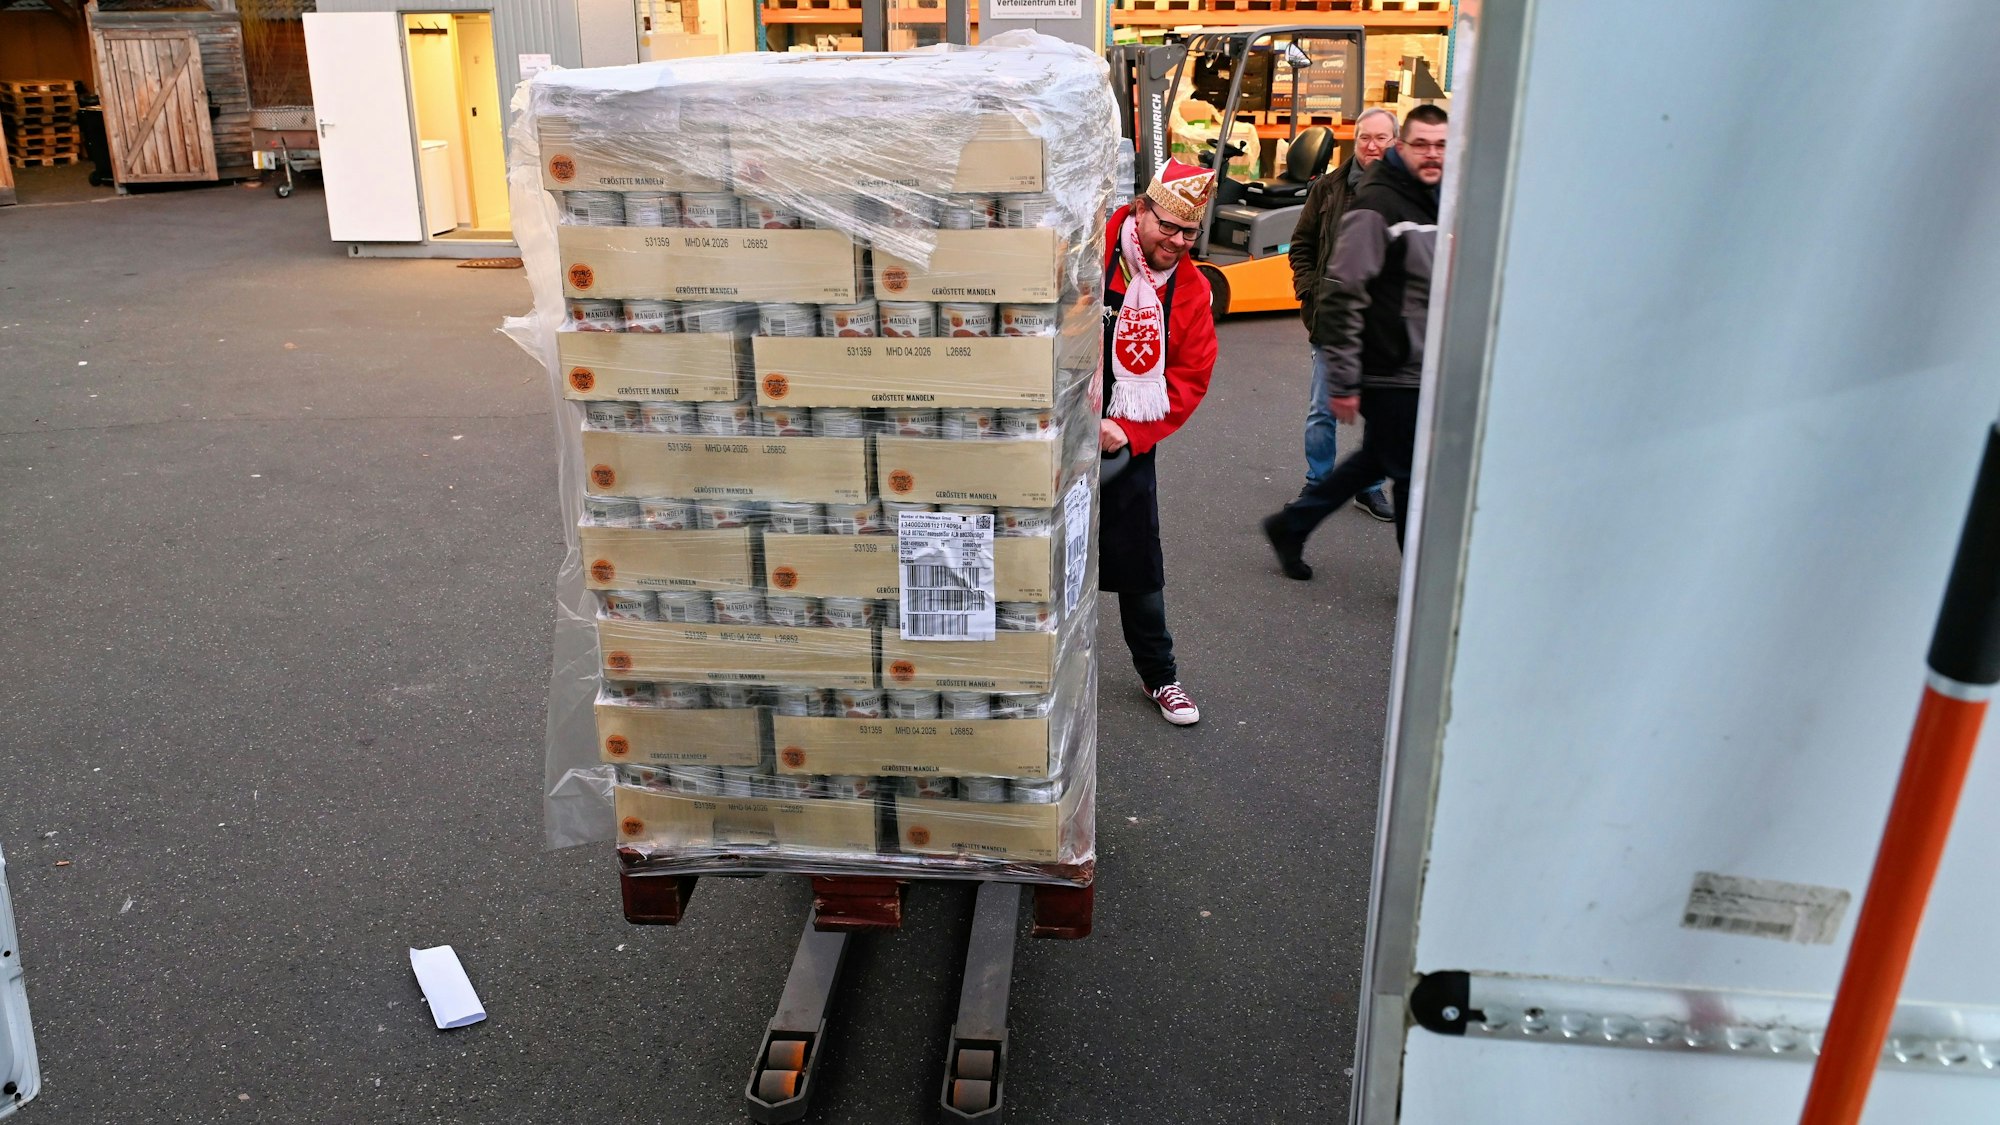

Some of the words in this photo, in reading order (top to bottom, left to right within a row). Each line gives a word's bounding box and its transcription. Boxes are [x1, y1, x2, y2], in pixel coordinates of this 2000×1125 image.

[645, 237, 670, 247] 531359
[684, 238, 700, 247] MHD
[702, 238, 729, 248] 04.2026
[742, 239, 768, 249] L26852
[675, 286, 708, 295] GERÖSTETE
[709, 287, 738, 295] MANDELN
[931, 287, 965, 296] GERÖSTETE
[966, 288, 996, 296] MANDELN
[585, 310, 614, 319] MANDELN
[634, 311, 663, 320] MANDELN
[849, 314, 875, 325] MANDELN
[889, 316, 917, 325] MANDELN
[965, 317, 992, 326] MANDELN
[1014, 316, 1043, 326] MANDELN
[847, 346, 872, 356] 531359
[886, 346, 903, 356] MHD
[904, 346, 931, 357] 04.2026
[946, 347, 971, 357] L26852
[617, 386, 650, 395] GERÖSTETE
[651, 387, 679, 395] MANDELN
[871, 393, 905, 402] GERÖSTETE
[906, 393, 935, 402] MANDELN
[667, 442, 692, 452] 531359
[705, 443, 722, 453] MHD
[762, 444, 786, 454] L26852
[693, 486, 725, 495] GERÖSTETE
[726, 487, 753, 495] MANDELN
[935, 490, 968, 499] GERÖSTETE
[969, 491, 997, 500] MANDELN
[656, 509, 684, 519] MANDELN
[854, 544, 877, 553] 531359
[615, 602, 642, 611] MANDELN
[725, 602, 753, 611] MANDELN
[936, 679, 968, 687] GERÖSTETE
[859, 725, 883, 735] 531359
[895, 726, 910, 735] MHD
[910, 726, 937, 735] 04.2026
[950, 727, 974, 736] L26852
[881, 764, 912, 772] GERÖSTETE
